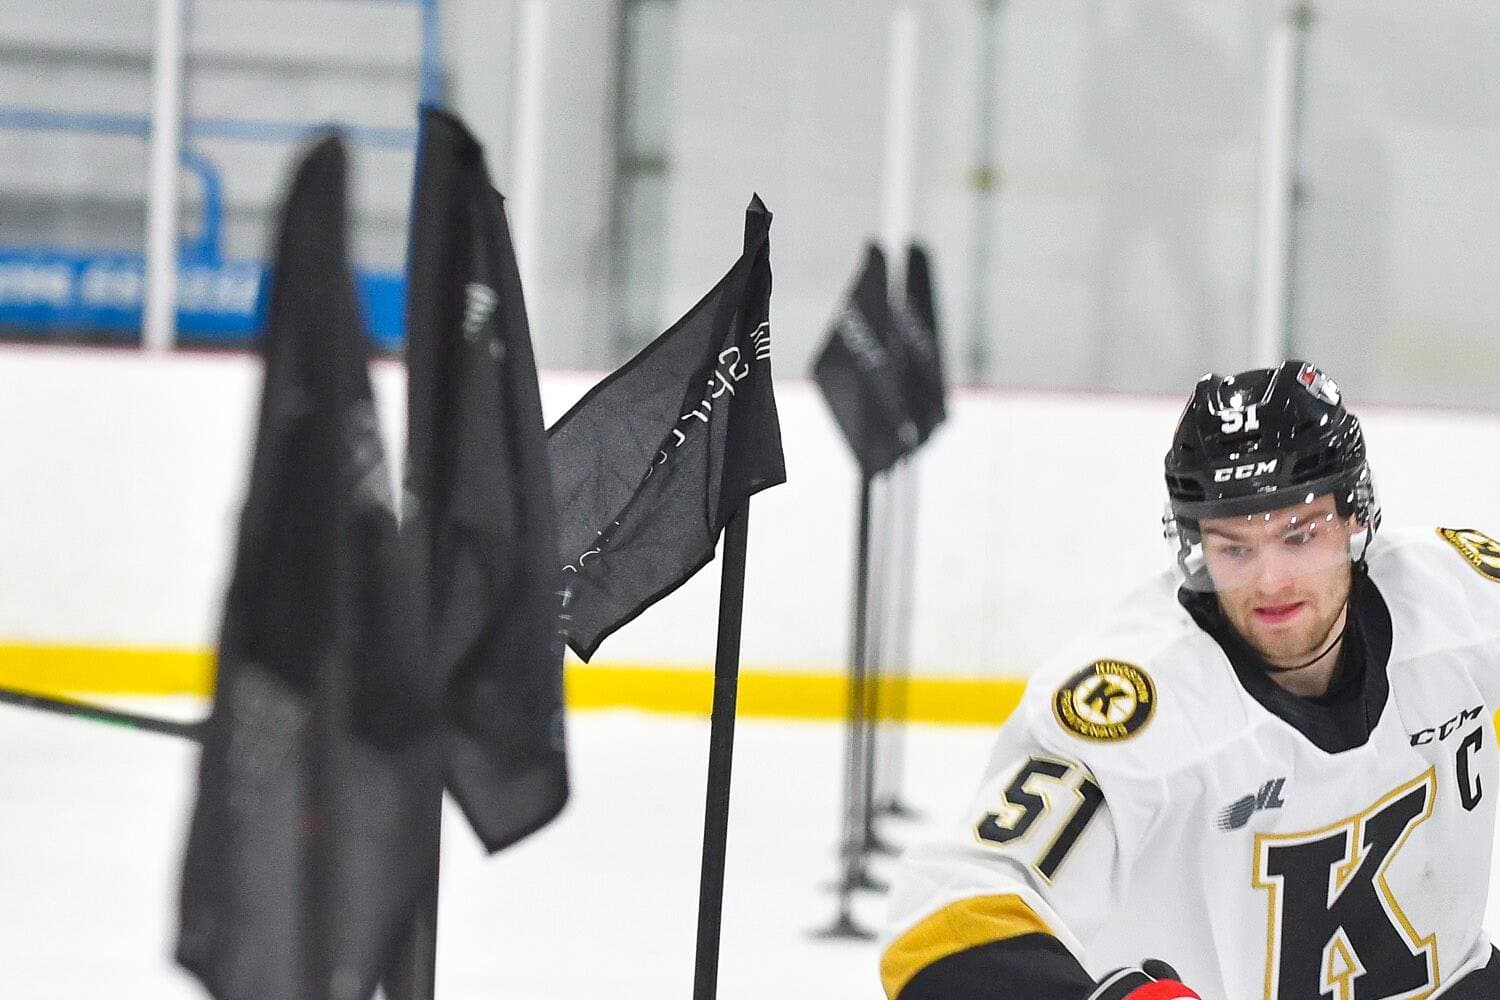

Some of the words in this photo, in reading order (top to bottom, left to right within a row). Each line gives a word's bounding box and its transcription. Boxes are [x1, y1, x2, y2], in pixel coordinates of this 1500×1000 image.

[1219, 404, 1260, 434] 51
[1213, 458, 1278, 482] CCM
[1083, 679, 1129, 720] K
[1407, 704, 1485, 748] CCM
[1455, 724, 1484, 812] C
[974, 755, 1106, 886] 51
